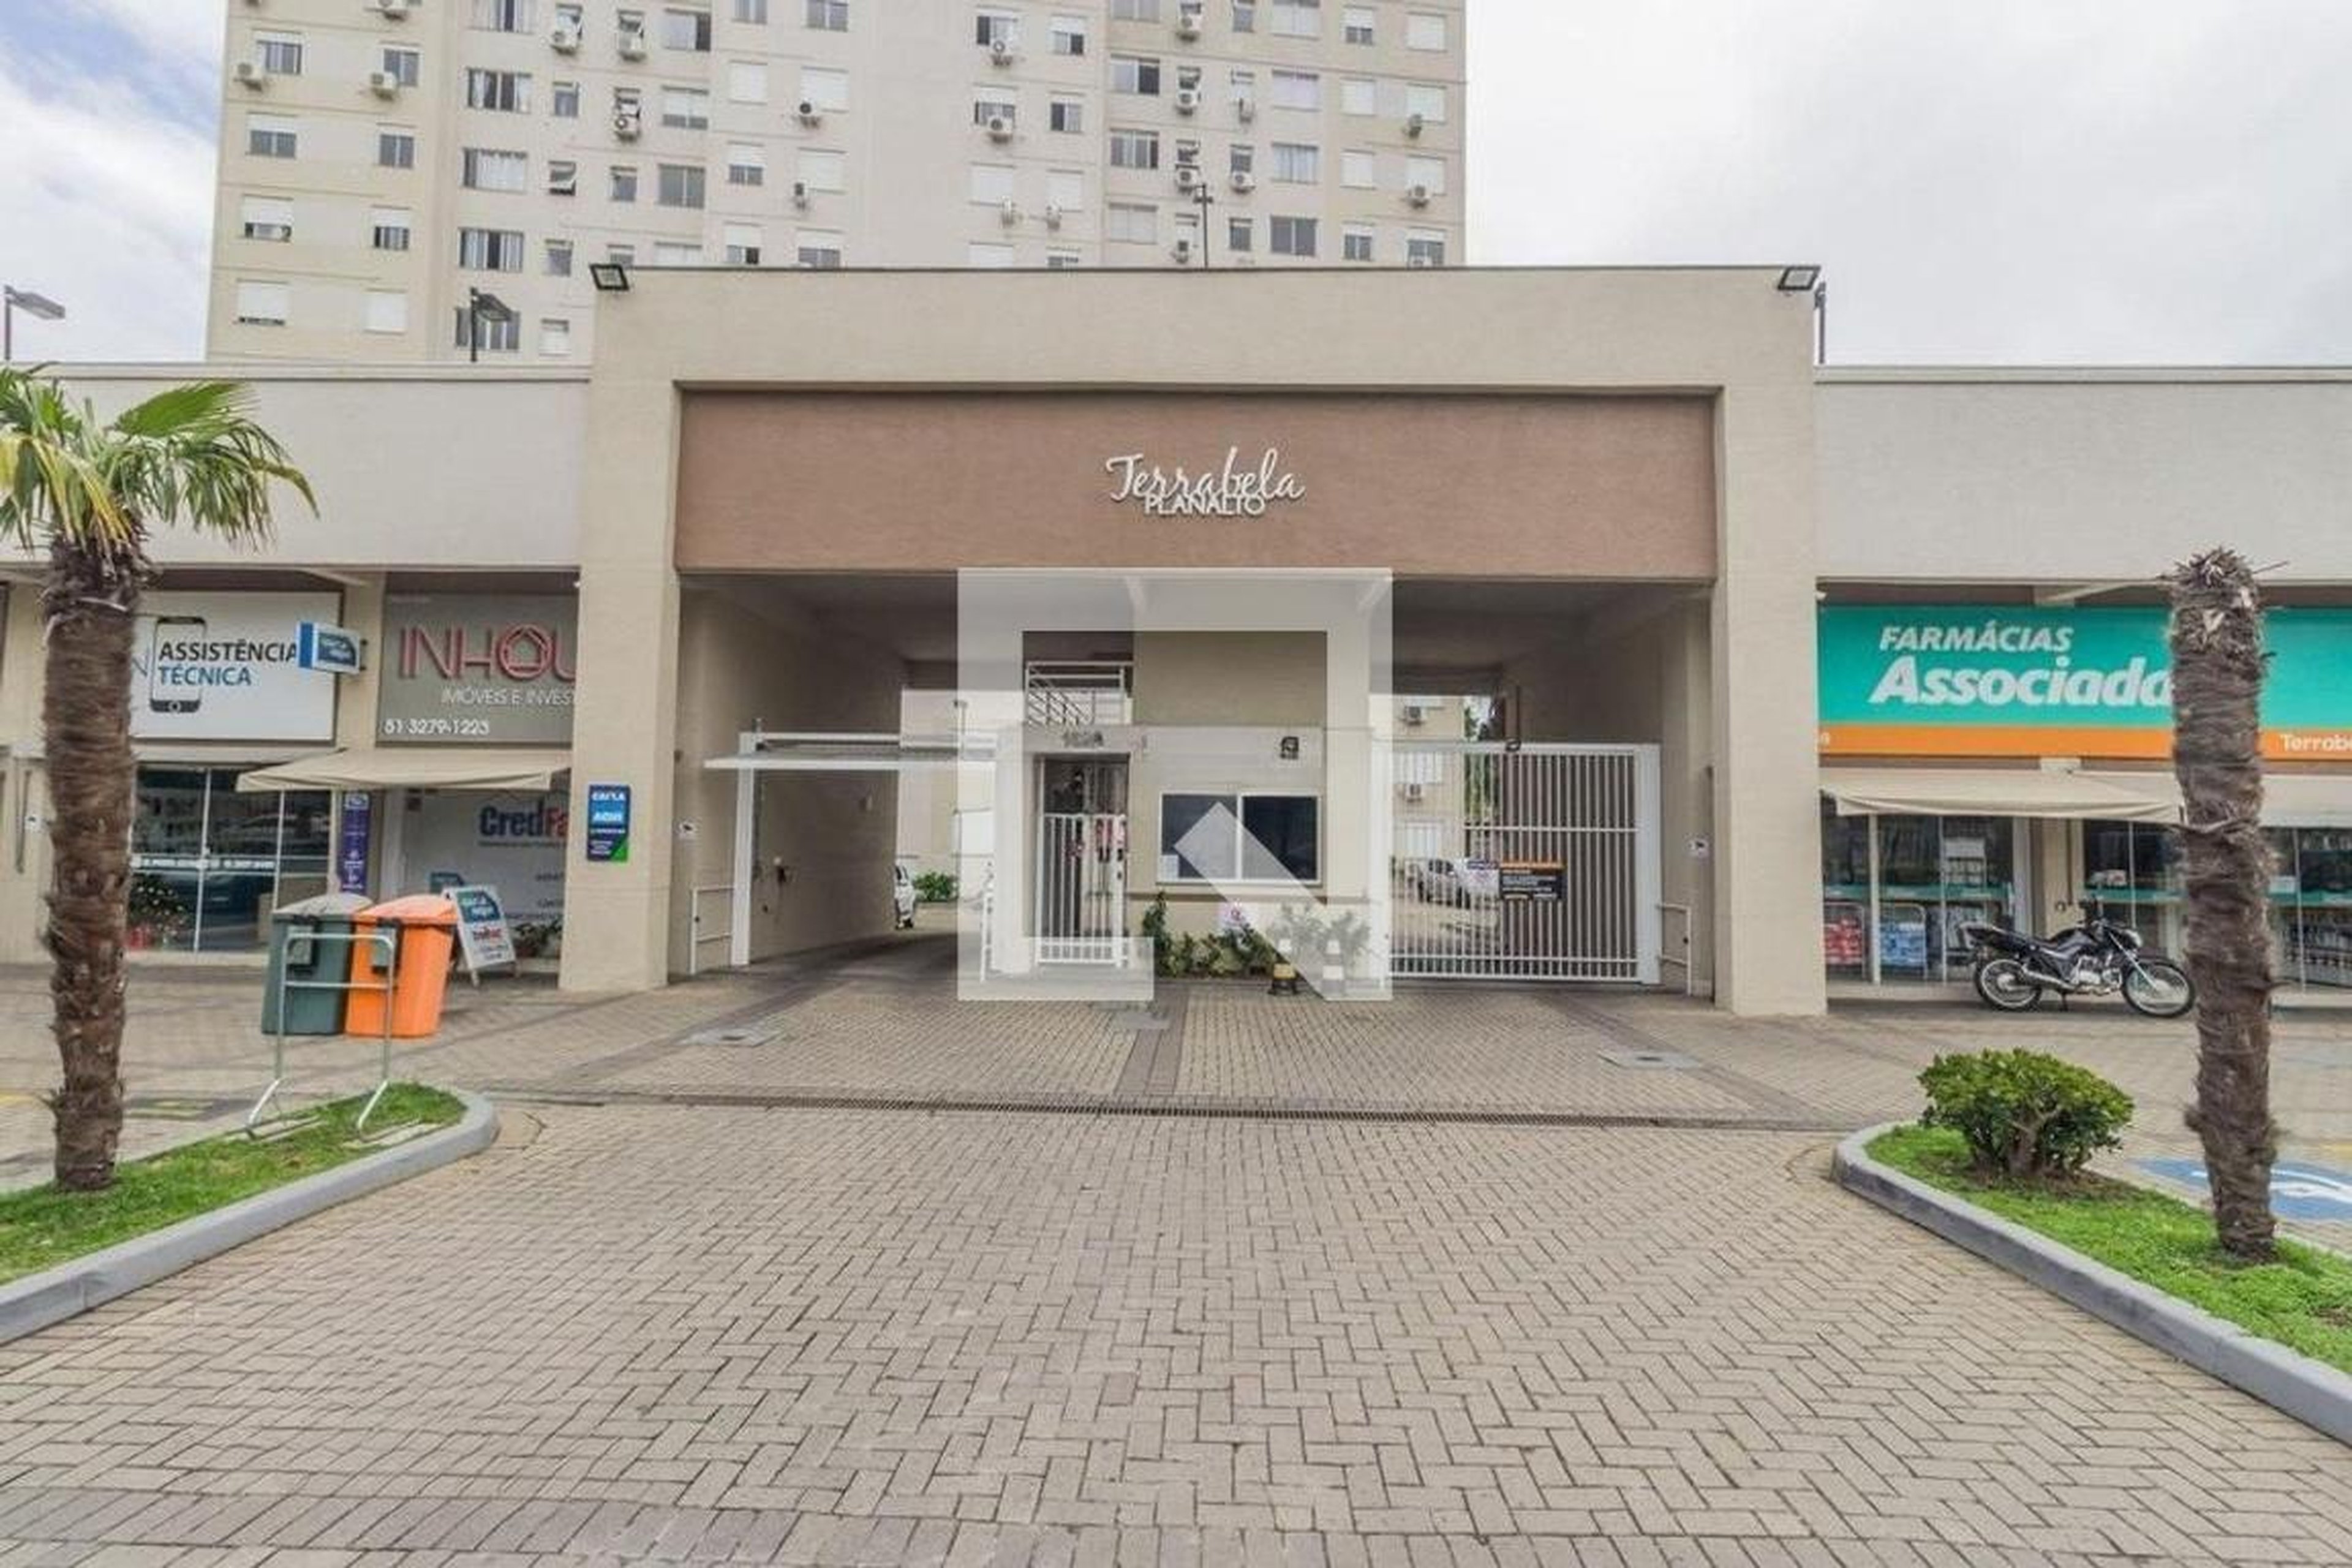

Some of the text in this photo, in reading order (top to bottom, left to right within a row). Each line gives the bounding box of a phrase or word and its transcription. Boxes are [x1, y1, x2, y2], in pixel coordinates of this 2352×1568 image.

[1105, 447, 1306, 502] Terrabela
[1144, 492, 1265, 516] PLANALTO
[1879, 621, 2075, 653] FARMÁCIAS
[158, 638, 297, 662] ASSISTÊNCIA
[157, 663, 252, 687] TÉCNICA
[441, 686, 507, 705] IMÓVEIS
[511, 689, 523, 704] E
